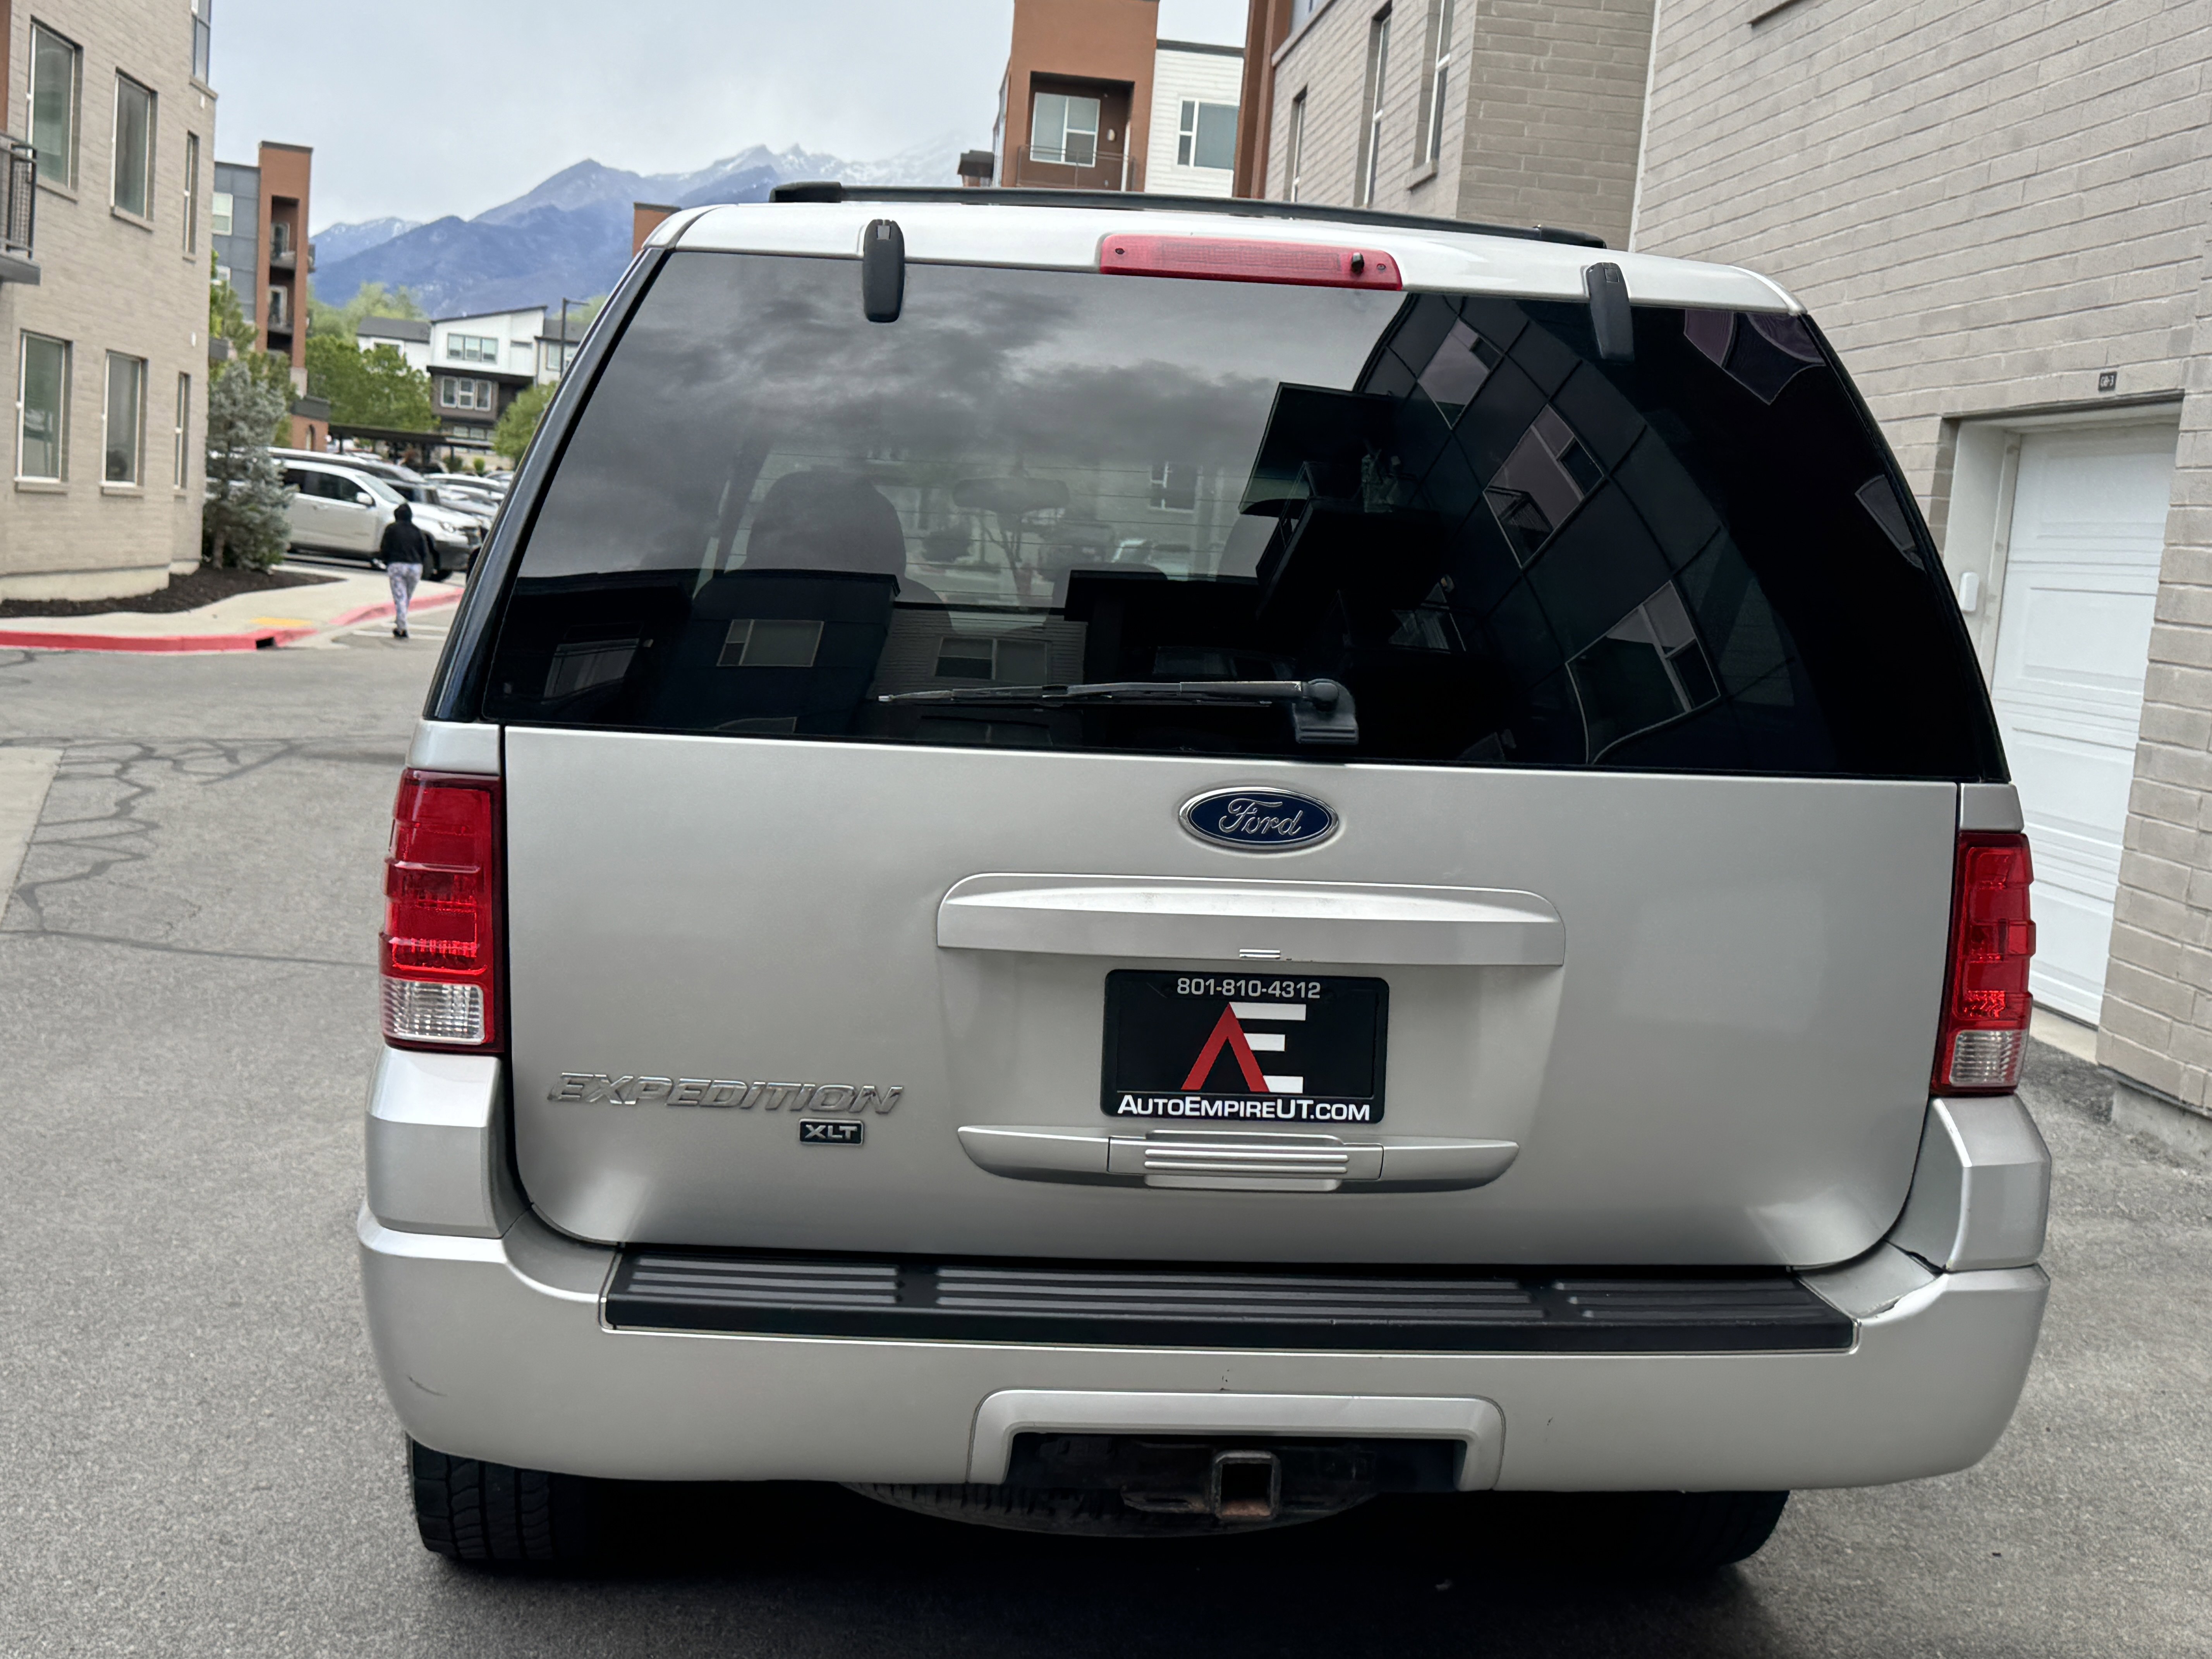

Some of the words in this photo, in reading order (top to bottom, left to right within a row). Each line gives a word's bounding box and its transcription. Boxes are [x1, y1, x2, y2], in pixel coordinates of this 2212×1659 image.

[1219, 798, 1303, 836] Ford
[1177, 977, 1321, 999] 801-810-4312
[547, 1072, 903, 1114] EXPEDITION
[804, 1124, 858, 1141] XLT
